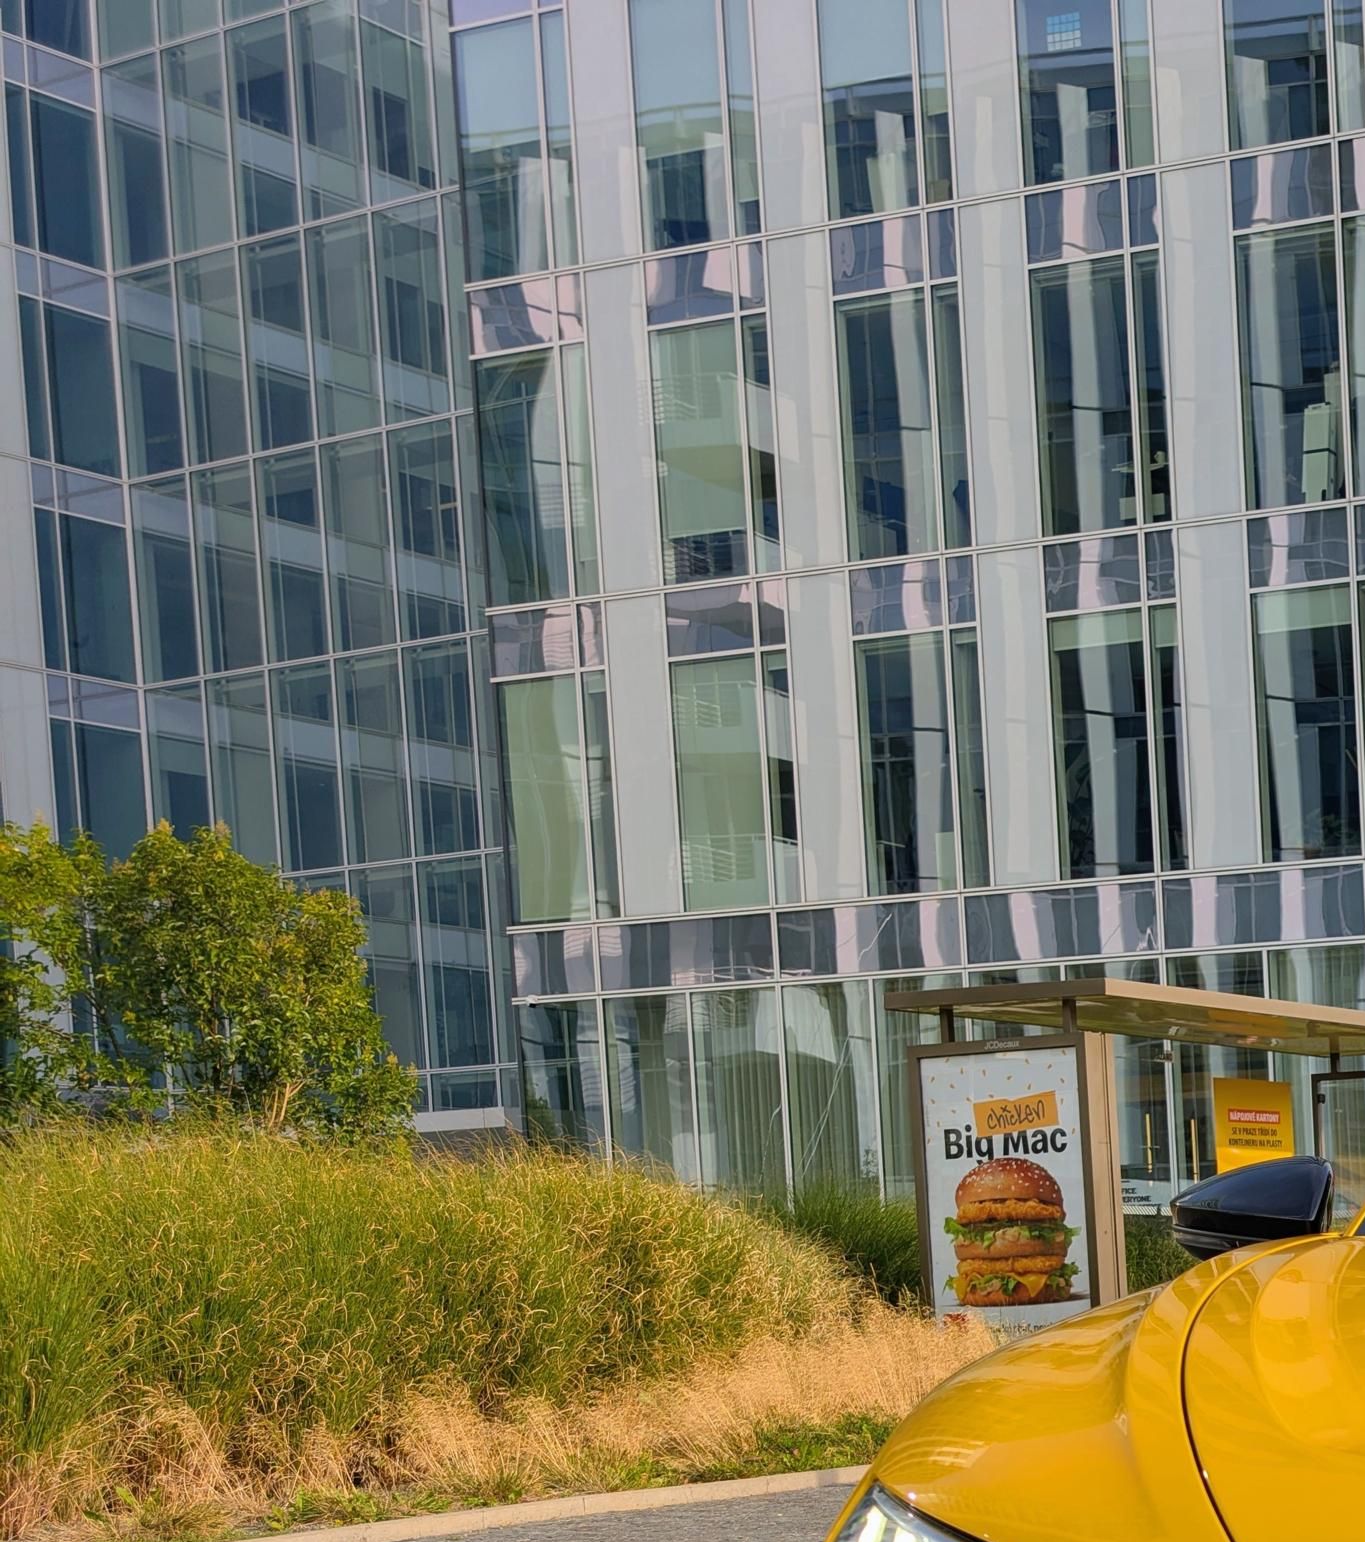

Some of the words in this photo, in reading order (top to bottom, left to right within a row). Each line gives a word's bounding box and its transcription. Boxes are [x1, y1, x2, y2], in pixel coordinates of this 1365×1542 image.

[984, 1040, 1020, 1050] JCDecaux
[944, 1124, 994, 1165] Big
[1002, 1127, 1068, 1156] Mac
